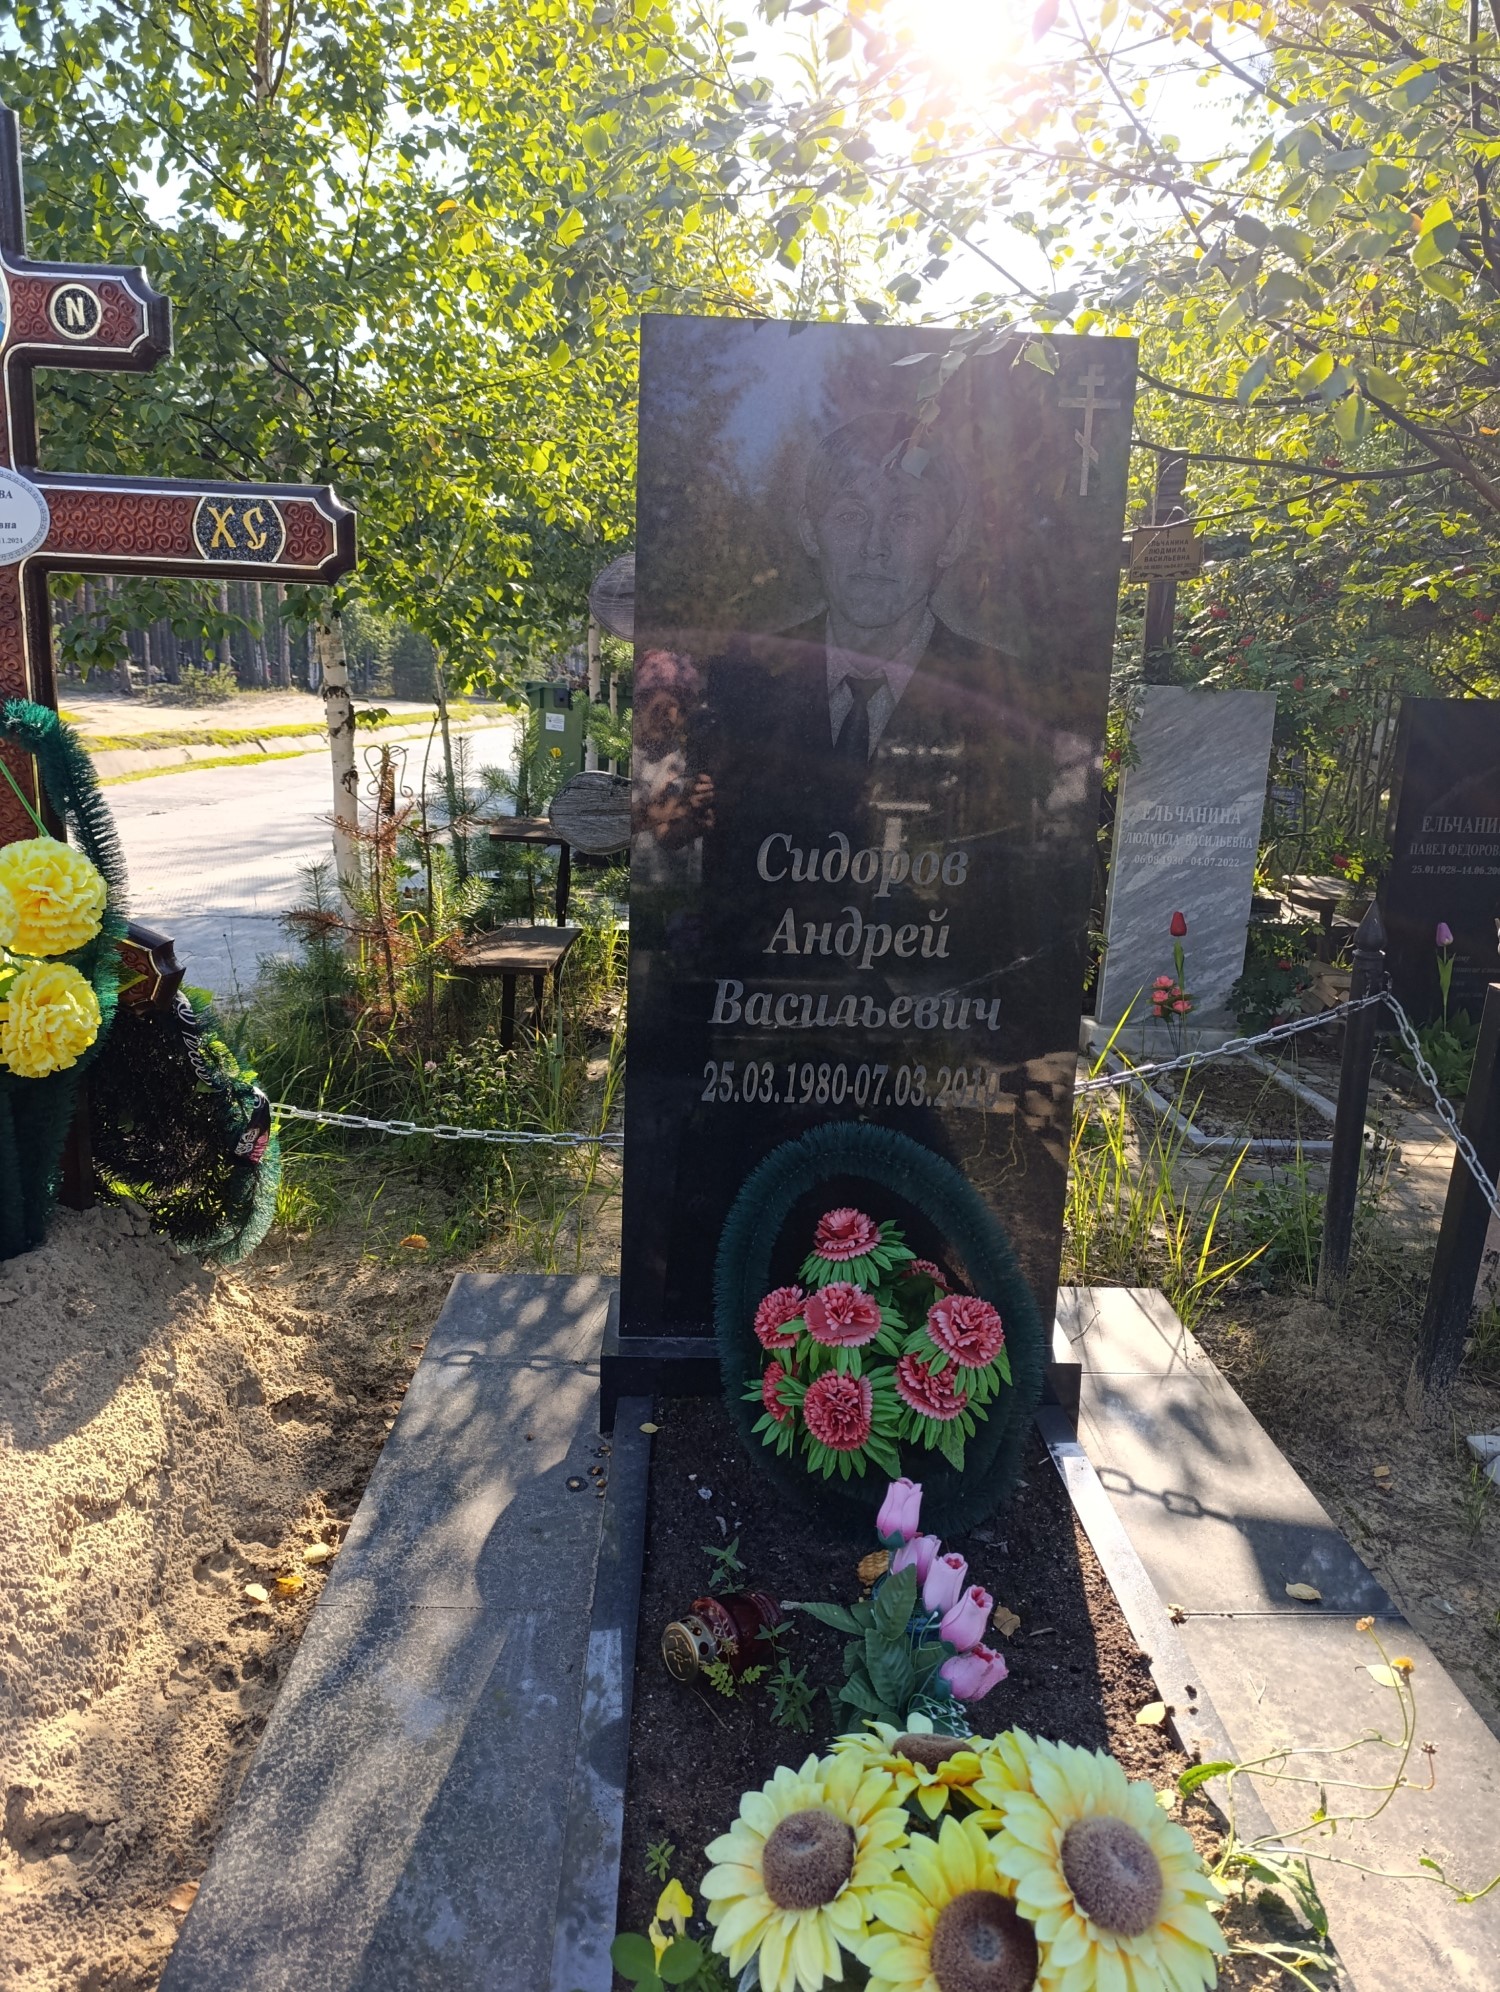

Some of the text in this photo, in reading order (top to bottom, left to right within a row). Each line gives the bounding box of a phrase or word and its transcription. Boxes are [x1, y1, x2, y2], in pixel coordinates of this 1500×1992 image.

[1144, 555, 1190, 563] ВАСИЛЬЕВНА
[1142, 805, 1241, 824] ЕЛЬЧАНИНА
[1422, 816, 1500, 833] ЕЛЬЧАНИ
[1124, 832, 1253, 848] ЛЮДМИЛА ВАСИЛЬЕВНА
[1410, 843, 1500, 857] ПАВЕЛ ФЕДОРОВ
[756, 831, 970, 897] Сидоров
[1191, 857, 1240, 867] 04.07.2022
[763, 906, 950, 970] Андрей
[707, 978, 1001, 1031] Васильевич
